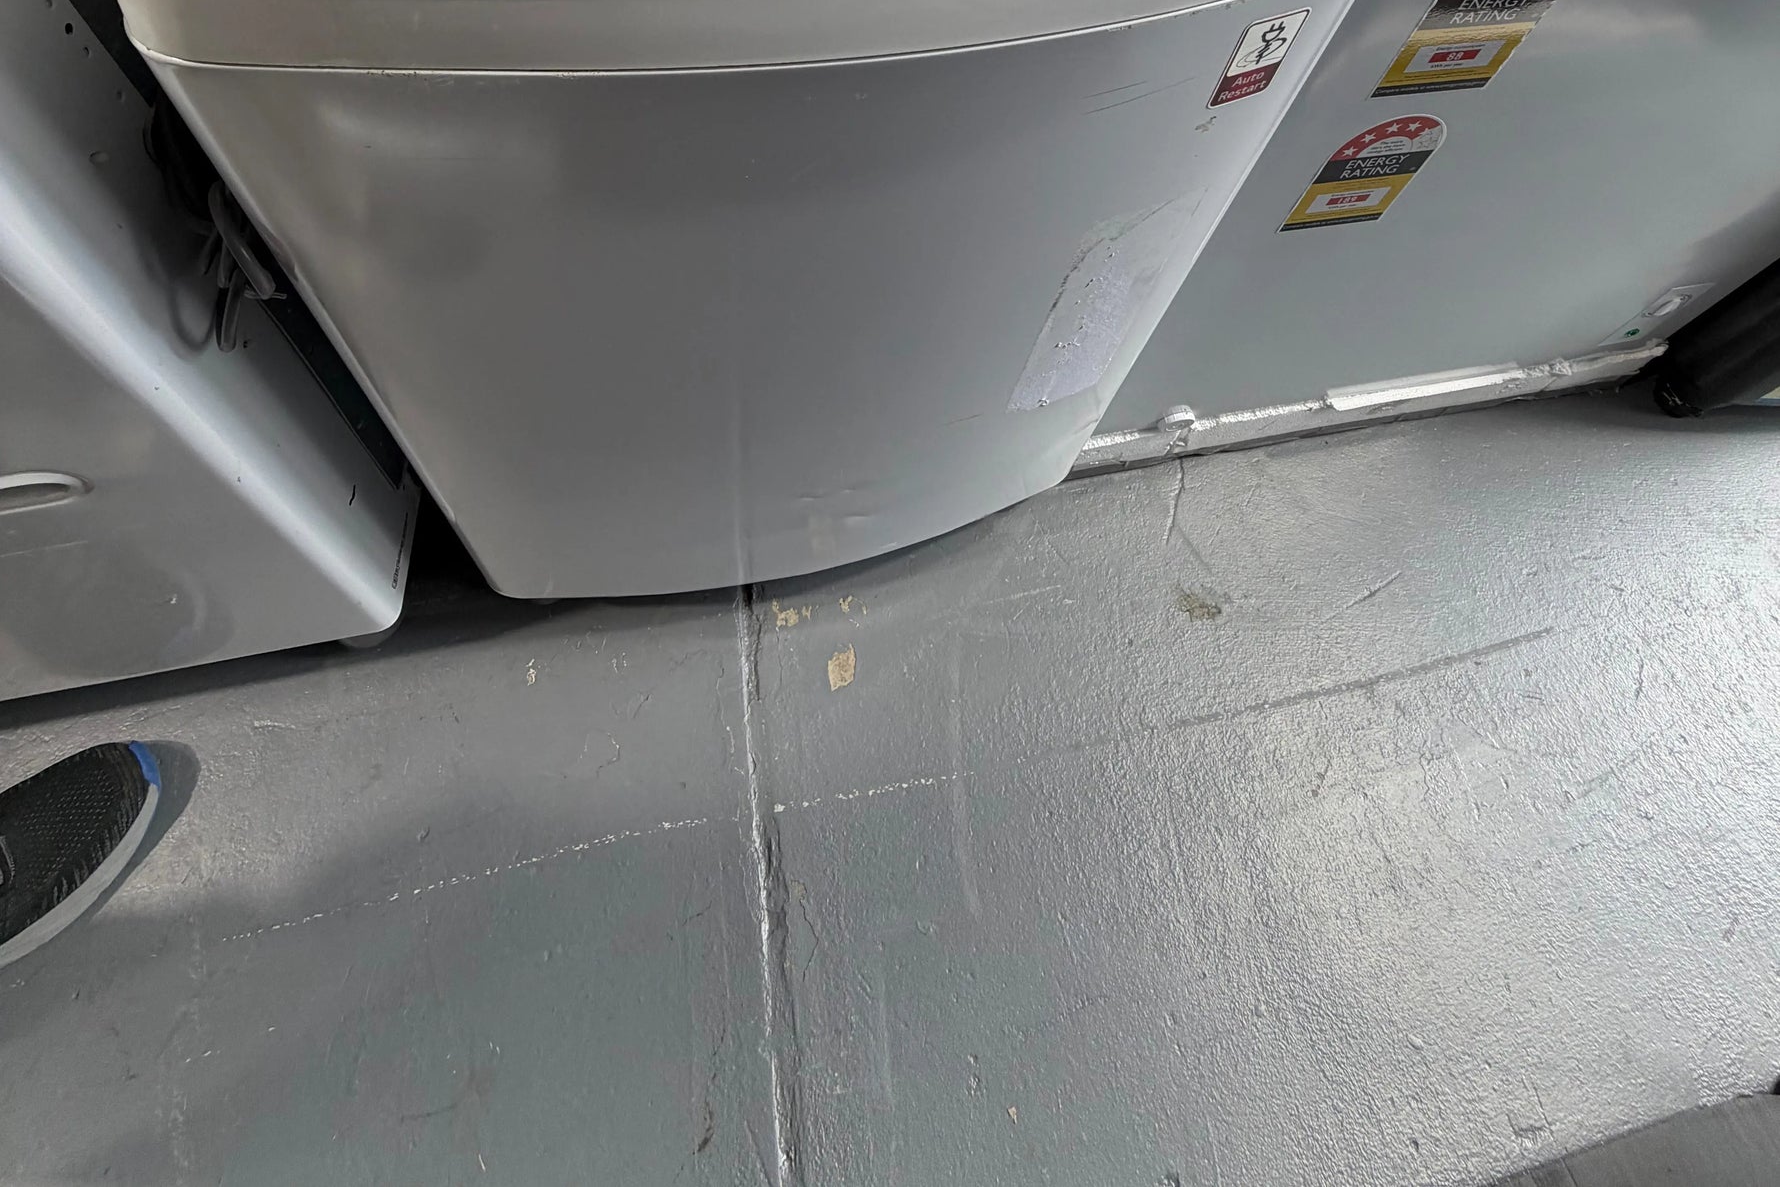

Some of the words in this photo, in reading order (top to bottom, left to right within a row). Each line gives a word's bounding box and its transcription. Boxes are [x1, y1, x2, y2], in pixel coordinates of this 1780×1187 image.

[1449, 7, 1521, 25] RATING
[1231, 71, 1265, 88] Auto
[1217, 80, 1267, 102] Restart
[1345, 153, 1410, 170] ENERGY
[1339, 164, 1400, 180] RATING
